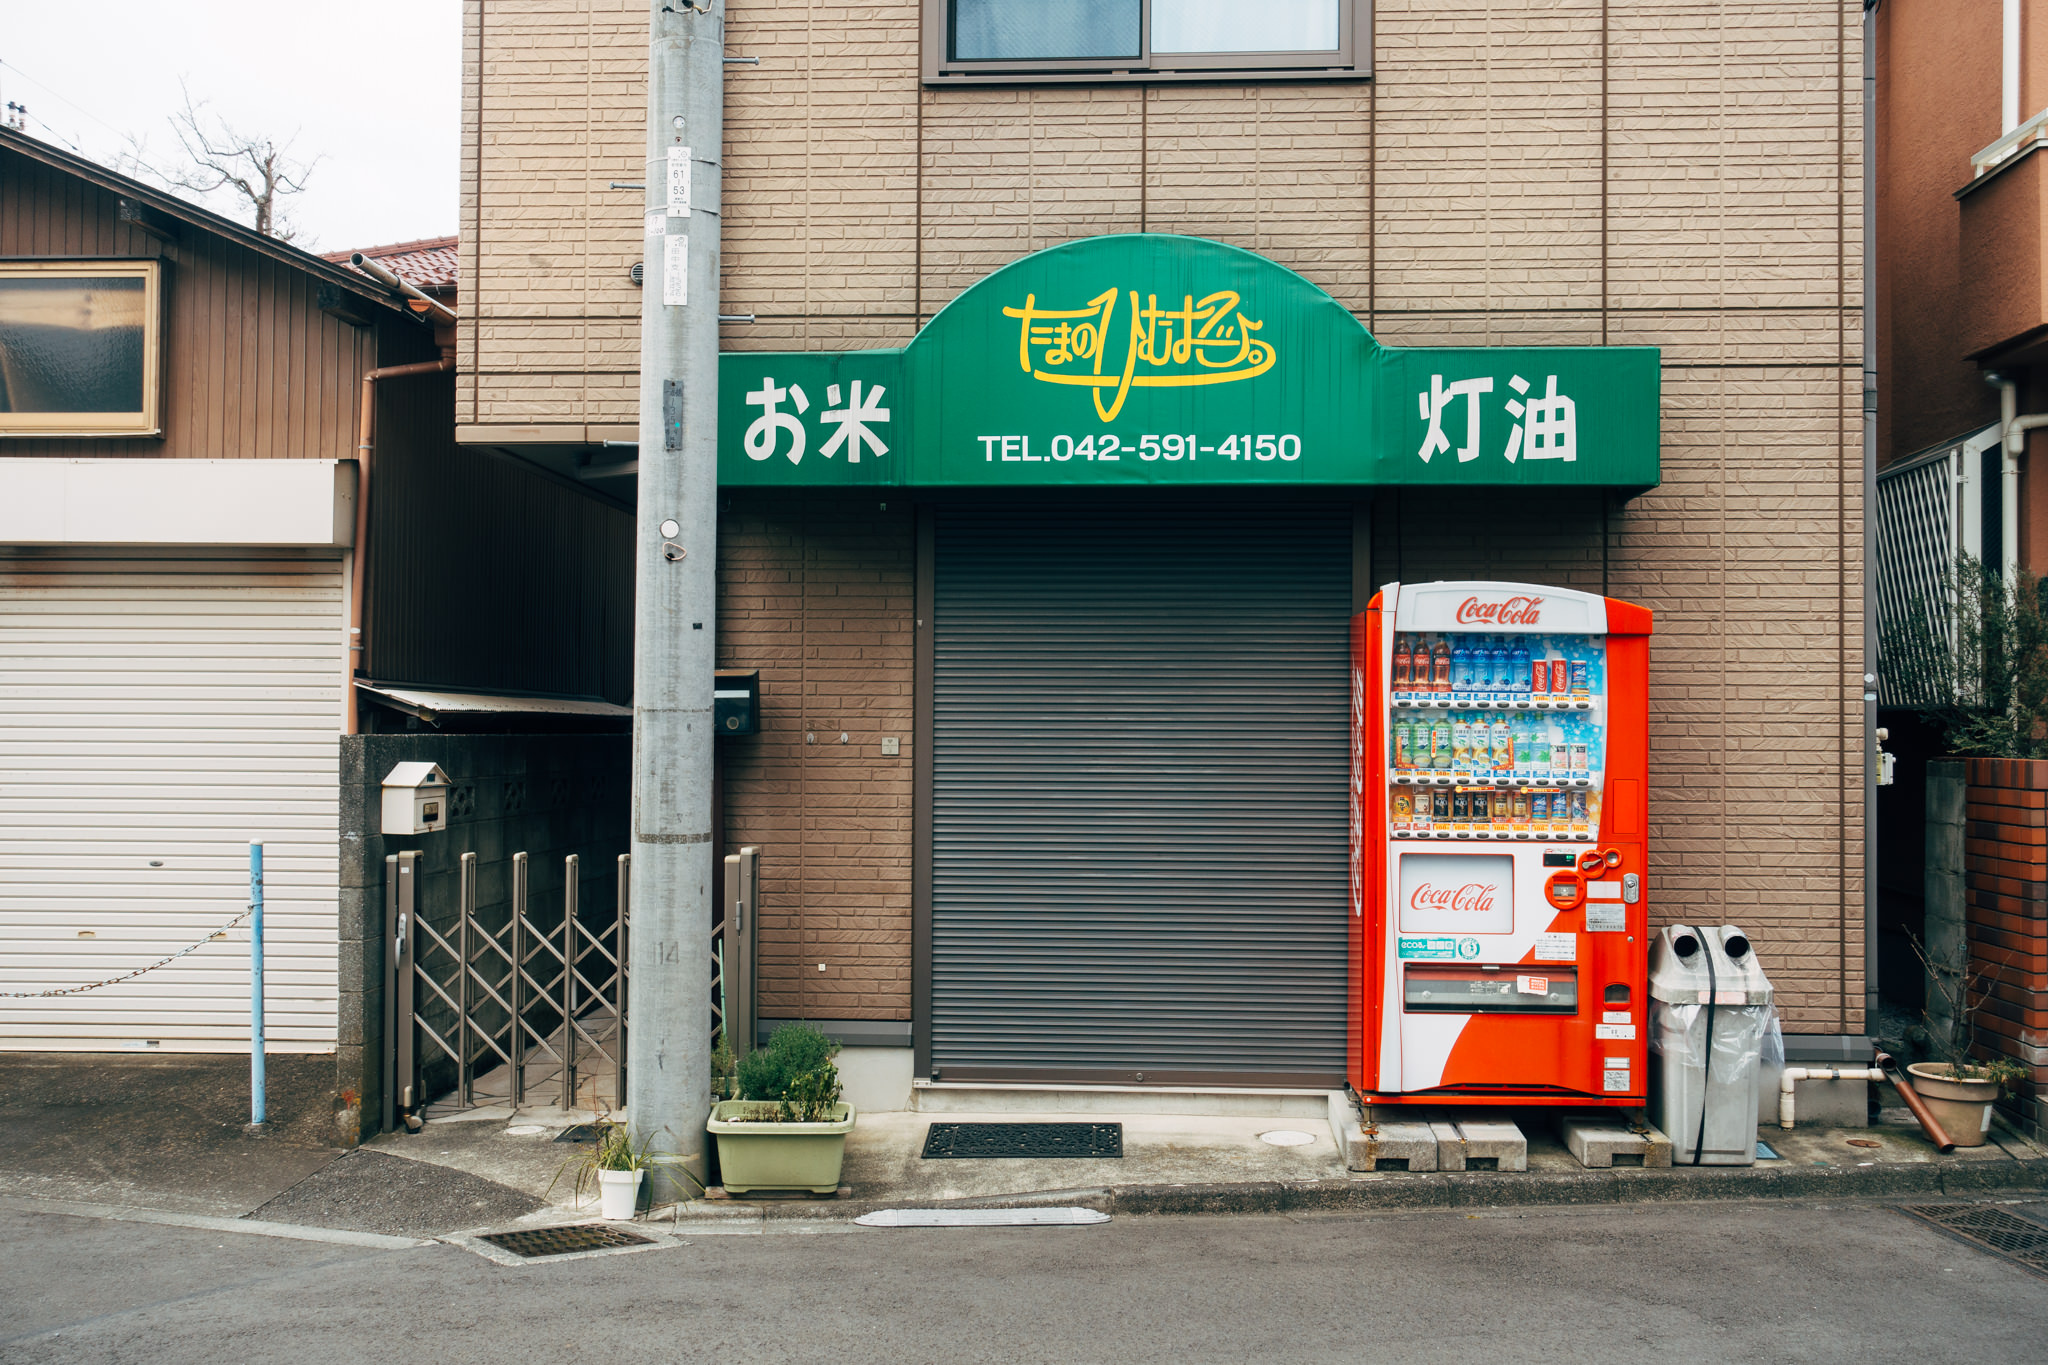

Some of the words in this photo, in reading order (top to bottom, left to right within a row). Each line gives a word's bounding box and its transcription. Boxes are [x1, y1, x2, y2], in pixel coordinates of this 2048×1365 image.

[673, 169, 684, 179] 61
[673, 185, 685, 195] 53
[744, 377, 890, 465] お米
[1418, 374, 1577, 464] 灯油
[977, 434, 1302, 462] TEL.042-591-4150
[1456, 596, 1545, 625] Coca-Cola
[1410, 882, 1499, 911] Coca-Cola
